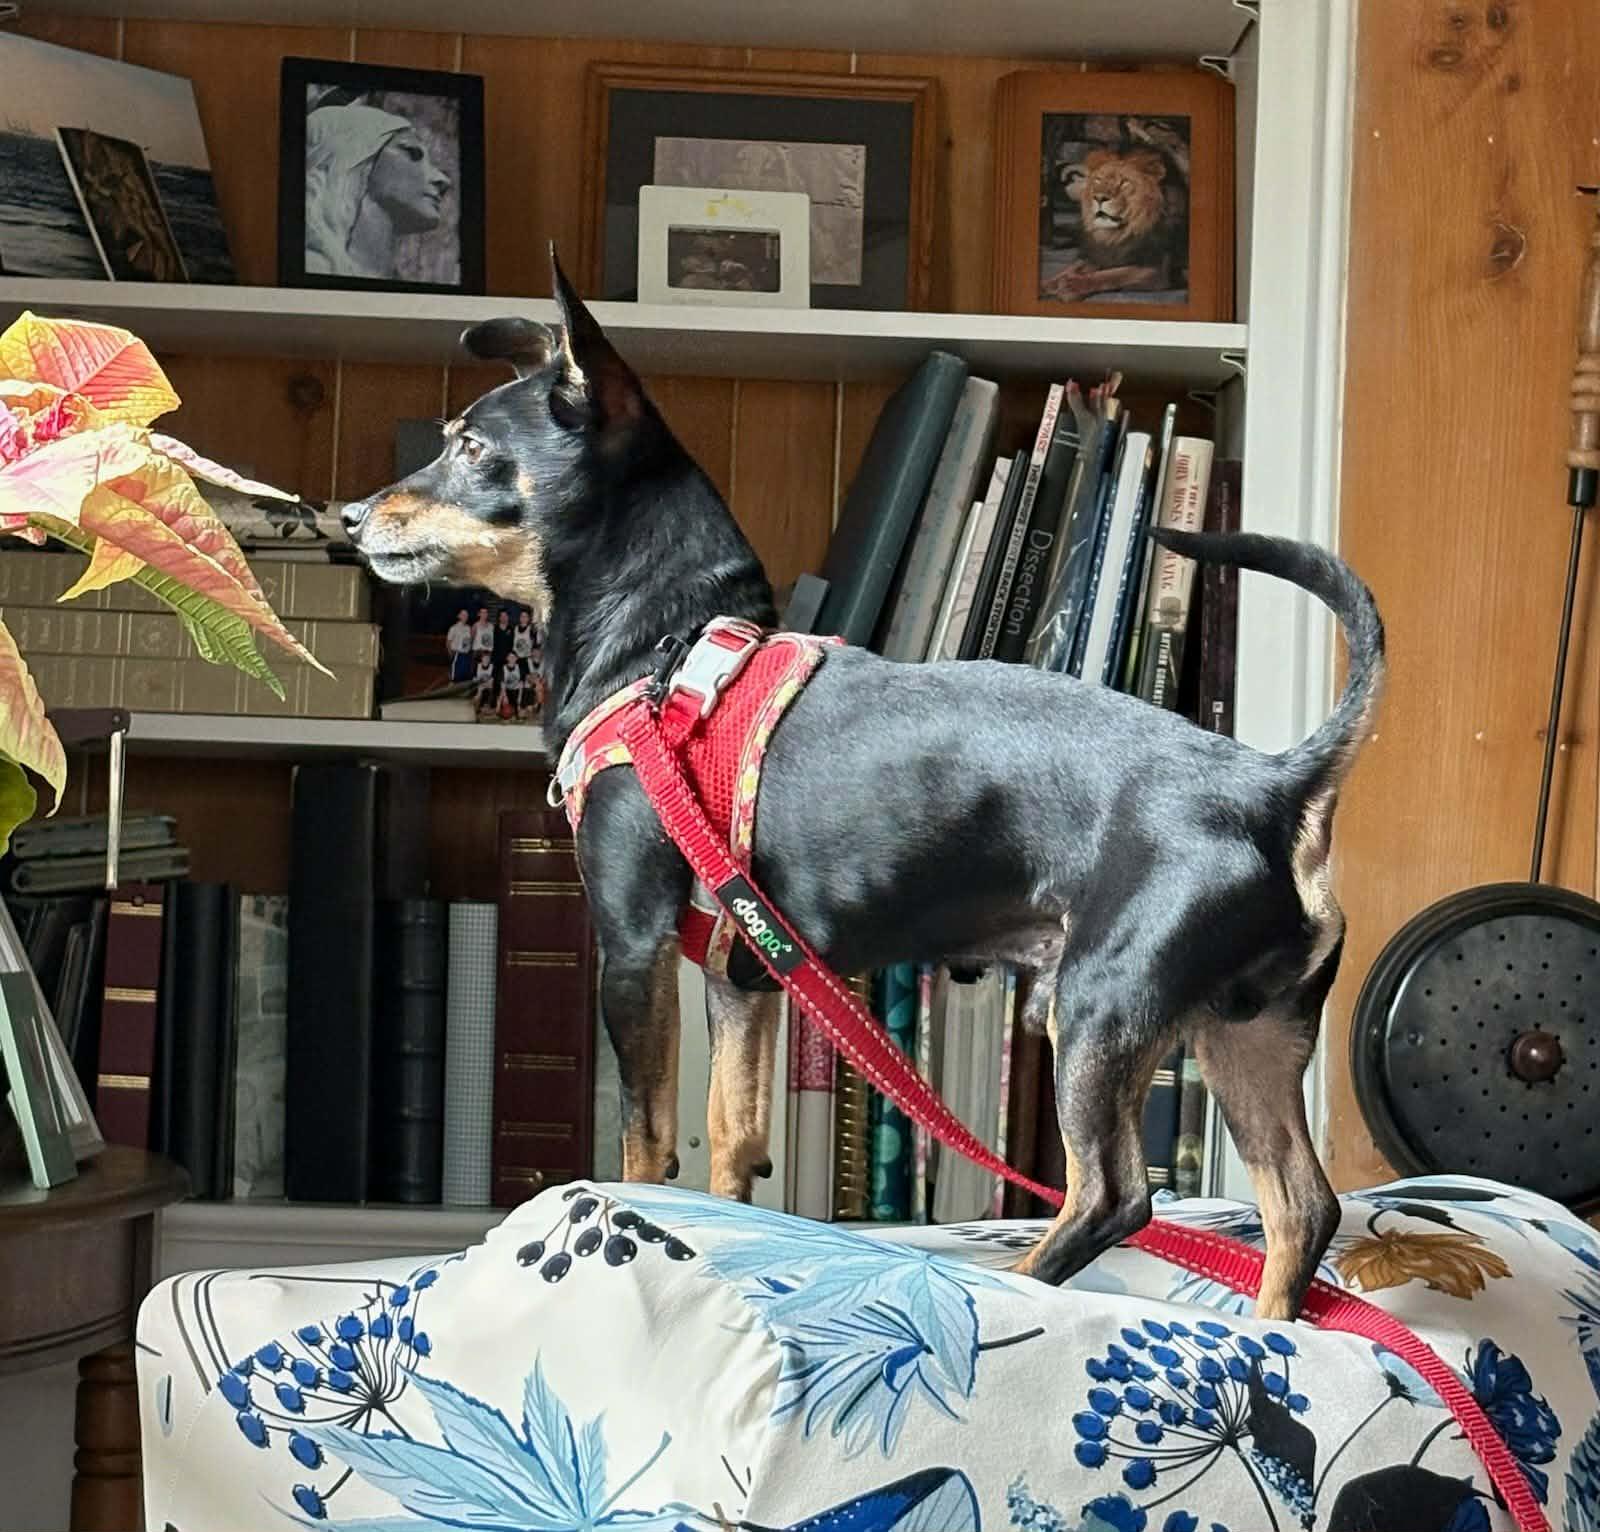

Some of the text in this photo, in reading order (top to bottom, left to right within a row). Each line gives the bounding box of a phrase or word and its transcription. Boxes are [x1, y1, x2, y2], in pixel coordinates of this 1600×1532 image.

[1027, 463, 1041, 483] THE
[1176, 453, 1192, 481] JOHN
[1169, 487, 1187, 522] MOSES
[997, 571, 1013, 600] BACK
[1006, 529, 1054, 636] Dissection
